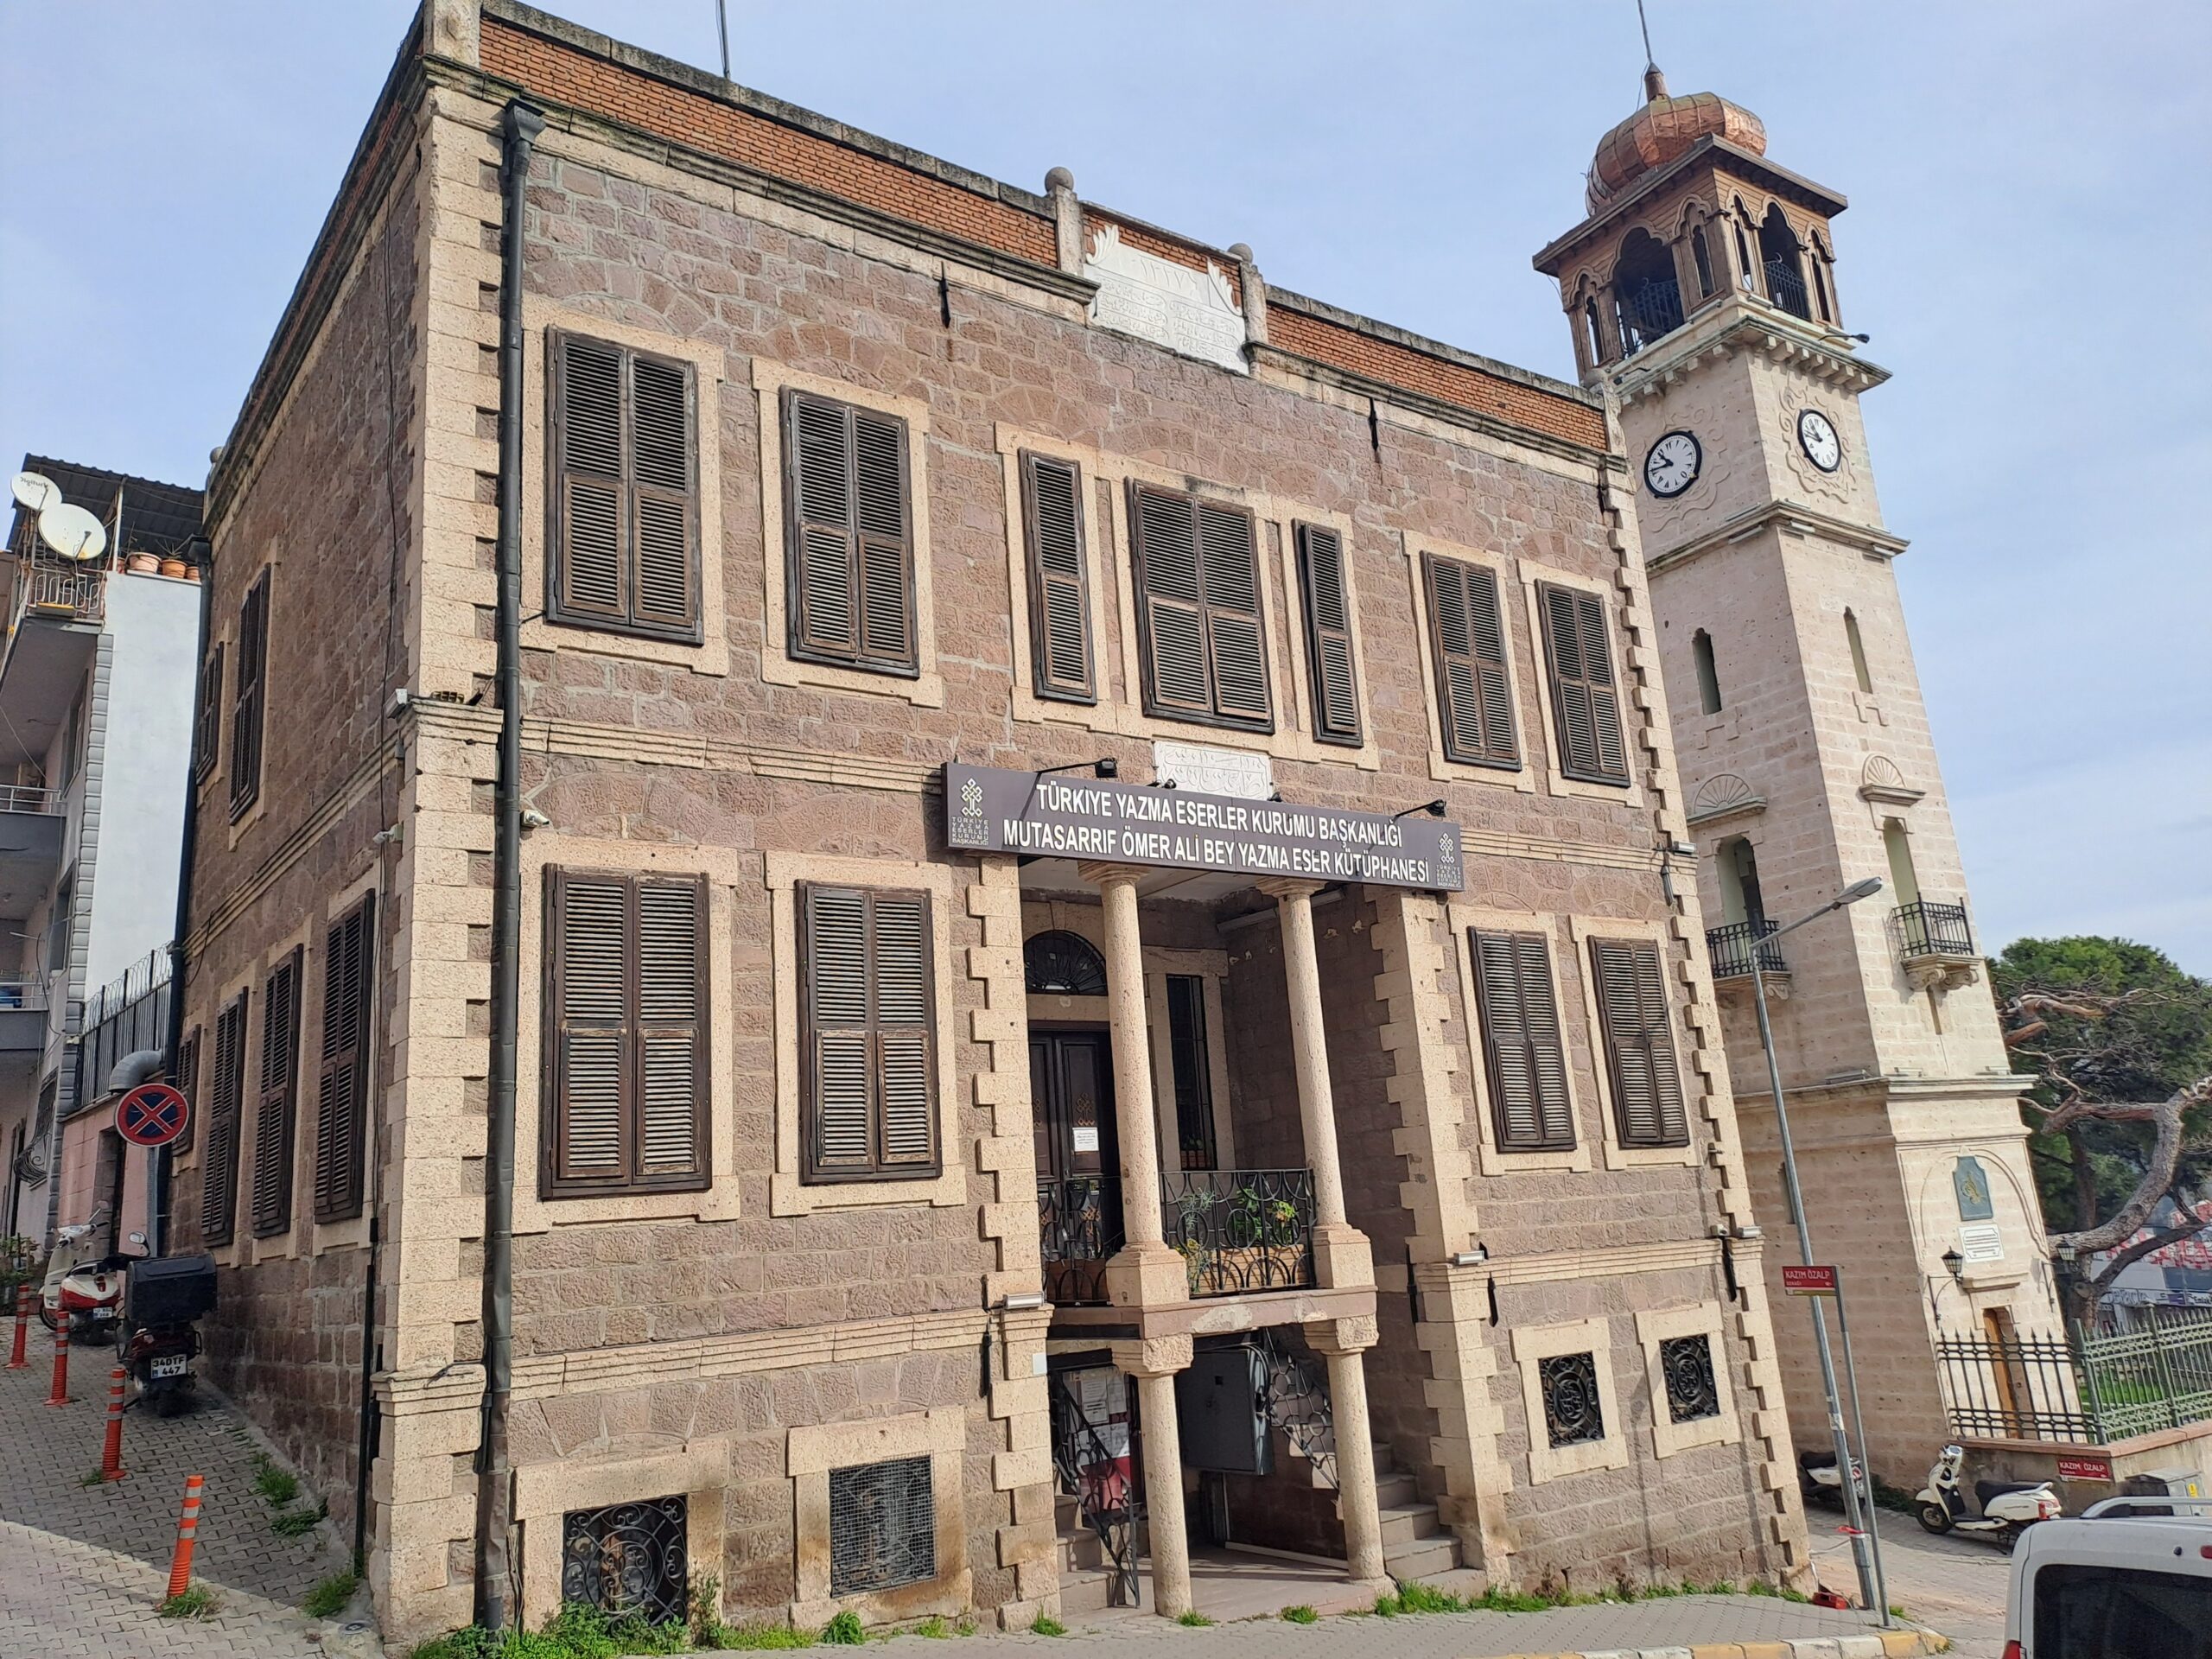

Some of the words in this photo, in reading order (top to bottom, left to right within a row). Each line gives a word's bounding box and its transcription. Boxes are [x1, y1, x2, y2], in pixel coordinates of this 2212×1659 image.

[1036, 780, 1112, 817] TÜRKİYE
[1115, 793, 1171, 823] YAZMA
[1176, 799, 1247, 831] ESERLER
[1252, 810, 1315, 839] KURUMU
[1319, 817, 1402, 848] BAŞKANLIĞI
[1003, 819, 1116, 855] MUTASARRIF
[1122, 825, 1172, 861] ÖMER
[1173, 834, 1200, 862] ALİ
[1204, 840, 1235, 865] BEY
[1237, 842, 1290, 870] YAZMA
[1293, 849, 1331, 874] ESER
[1334, 846, 1430, 883] KÜTÜPHANESİ
[1784, 1270, 1807, 1279] KAZIM
[1808, 1269, 1830, 1279] ÖZALP
[152, 1357, 184, 1367] 34DTF
[162, 1366, 181, 1376] 447
